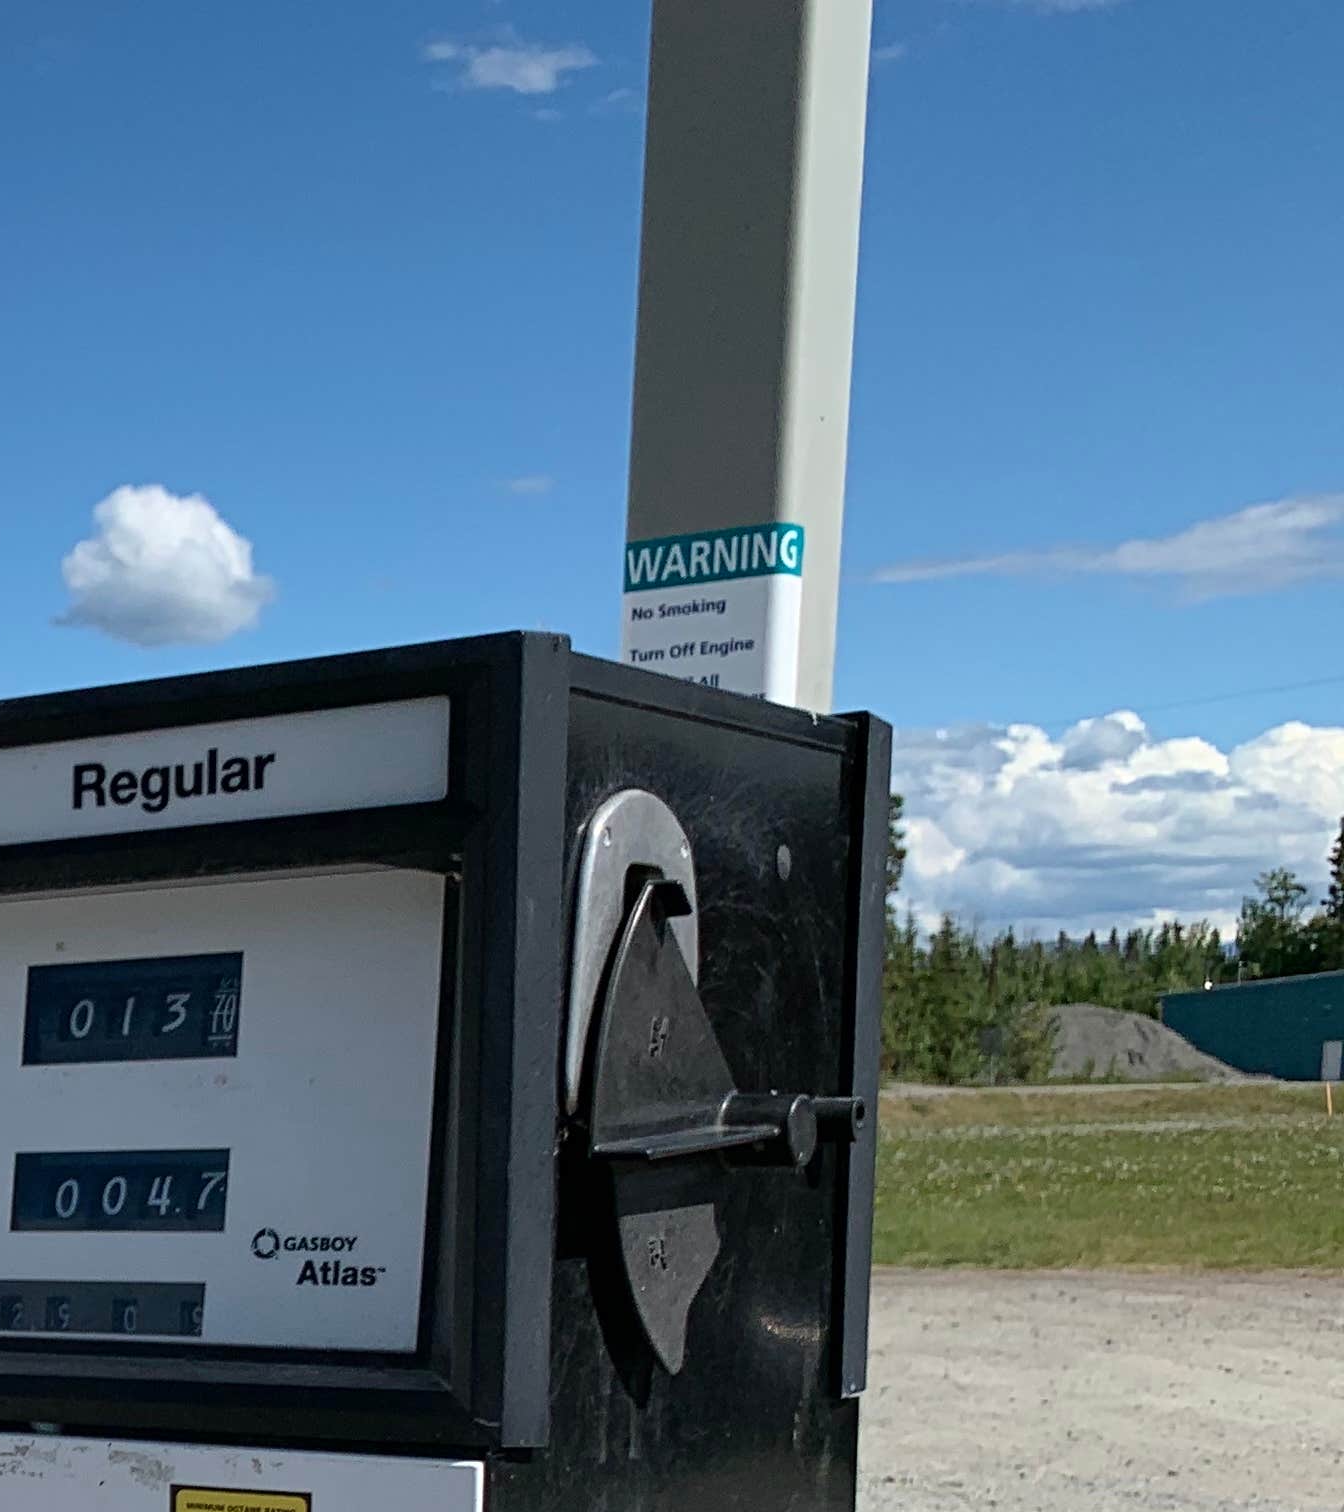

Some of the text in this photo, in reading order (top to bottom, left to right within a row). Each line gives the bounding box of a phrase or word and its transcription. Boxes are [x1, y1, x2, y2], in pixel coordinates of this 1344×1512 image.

[628, 530, 798, 585] WARNING
[631, 598, 726, 621] No Smoking
[630, 637, 755, 663] Turn Off Engine
[71, 748, 275, 814] Regular
[282, 1236, 358, 1253] GASBOY
[187, 1502, 225, 1512] MINIMUM
